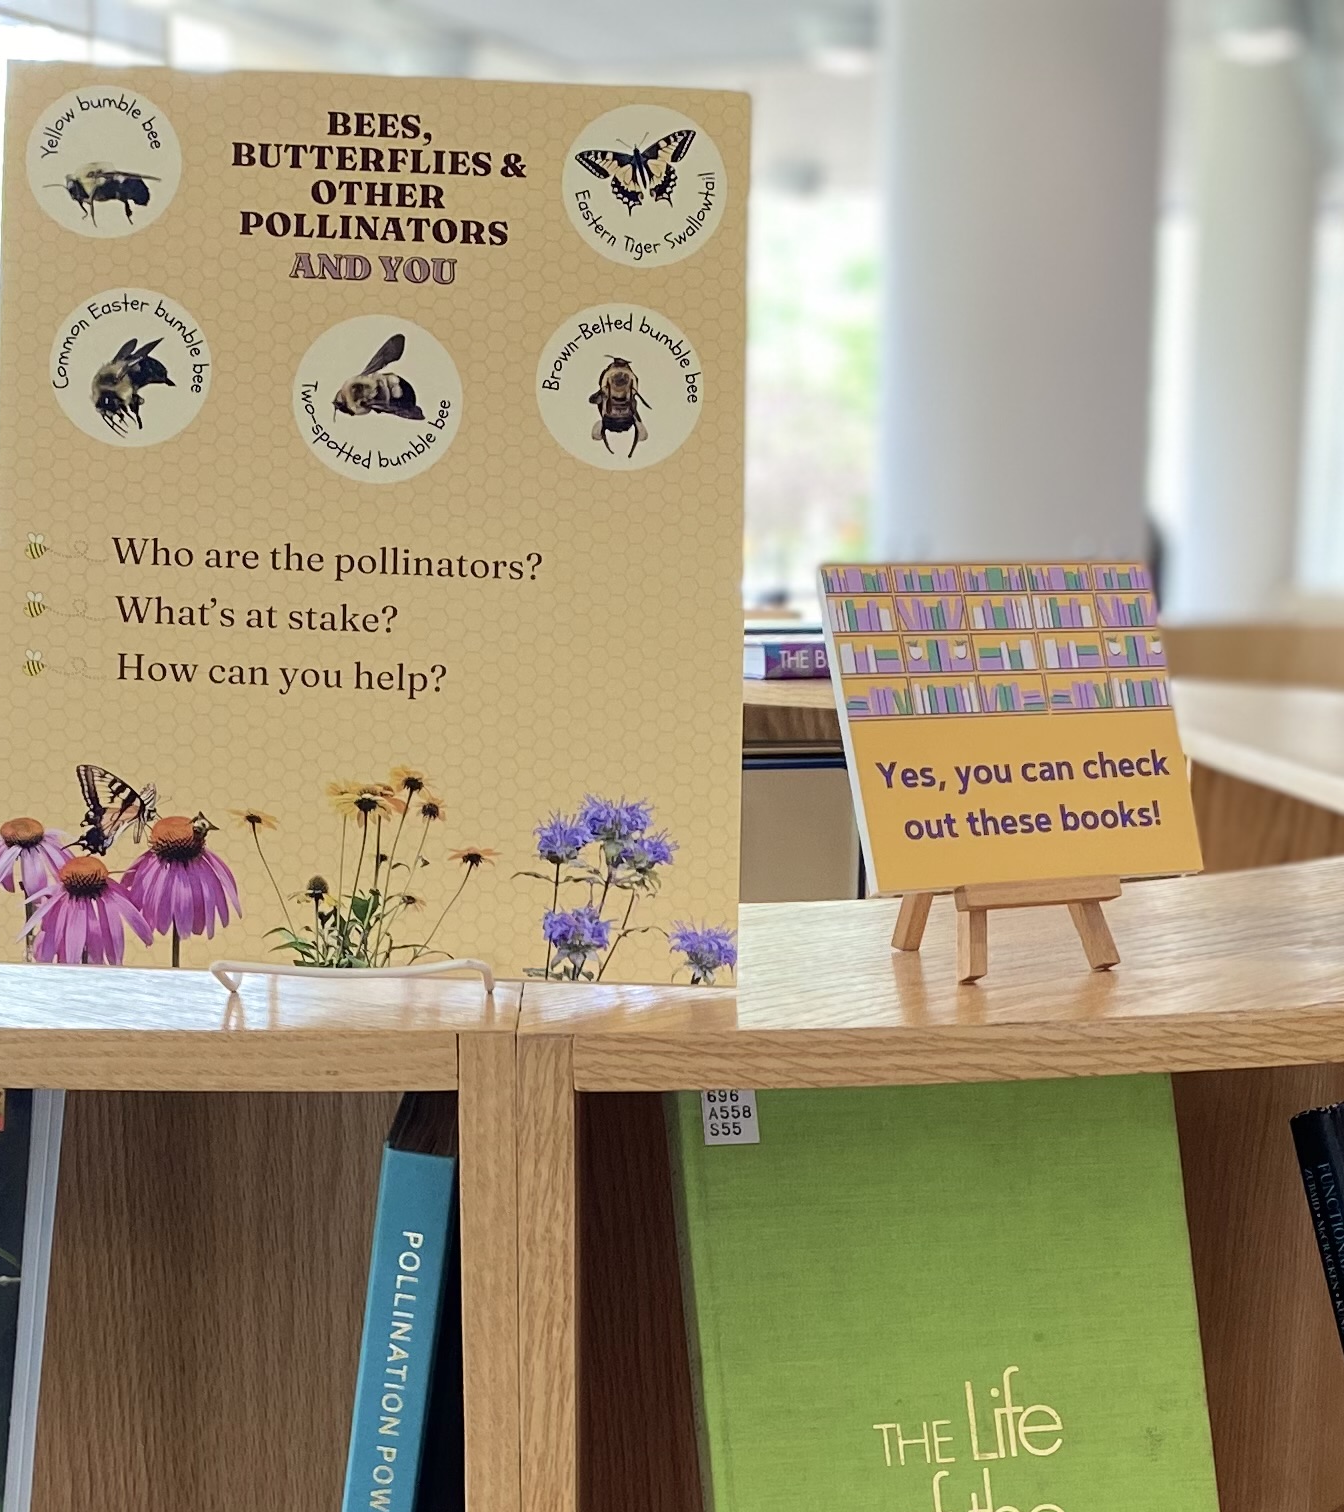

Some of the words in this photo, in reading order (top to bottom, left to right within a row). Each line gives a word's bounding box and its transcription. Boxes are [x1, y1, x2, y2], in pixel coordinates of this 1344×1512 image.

[40, 108, 75, 159] Yellow
[76, 94, 141, 119] bumble
[142, 116, 161, 150] bee
[327, 111, 433, 146] BEES,
[231, 142, 492, 177] BUTTERFLIES
[500, 153, 527, 178] &
[311, 179, 445, 209] OTHER
[239, 211, 509, 246] POLLINATORS
[575, 189, 617, 247] Eastern
[624, 235, 661, 261] Tiger
[663, 172, 716, 249] Swallowtail
[289, 252, 372, 281] AND
[378, 255, 458, 285] YOU
[52, 319, 90, 389] Common
[87, 293, 150, 320] Easter
[154, 300, 204, 358] bumble
[190, 363, 210, 394] bee
[542, 313, 633, 390] Brown-Belted
[638, 316, 691, 368] bumble
[685, 371, 701, 404] bee
[301, 381, 372, 469] Two-spotted
[377, 432, 437, 468] bumble
[427, 399, 451, 430] bee
[111, 537, 194, 568] Who
[204, 550, 260, 570] are
[269, 543, 325, 572] the
[335, 546, 543, 582] pollinators?
[115, 595, 236, 628] What’s
[246, 606, 278, 629] at
[287, 603, 398, 634] stake?
[116, 652, 199, 683] How
[208, 664, 269, 686] can
[278, 667, 344, 696] you
[354, 661, 447, 700] help?
[779, 649, 810, 670] THE
[875, 761, 946, 792] Yes,
[954, 763, 1010, 795] you
[1021, 756, 1074, 783] can
[1083, 748, 1171, 779] check
[904, 813, 959, 841] out
[966, 807, 1052, 837] these
[1058, 800, 1162, 832] books!
[707, 1090, 739, 1102] 696
[709, 1105, 751, 1119] A558
[710, 1122, 741, 1136] S55
[378, 1230, 425, 1437] POLLINATION
[873, 1419, 956, 1467] THE
[964, 1366, 1064, 1461] Life
